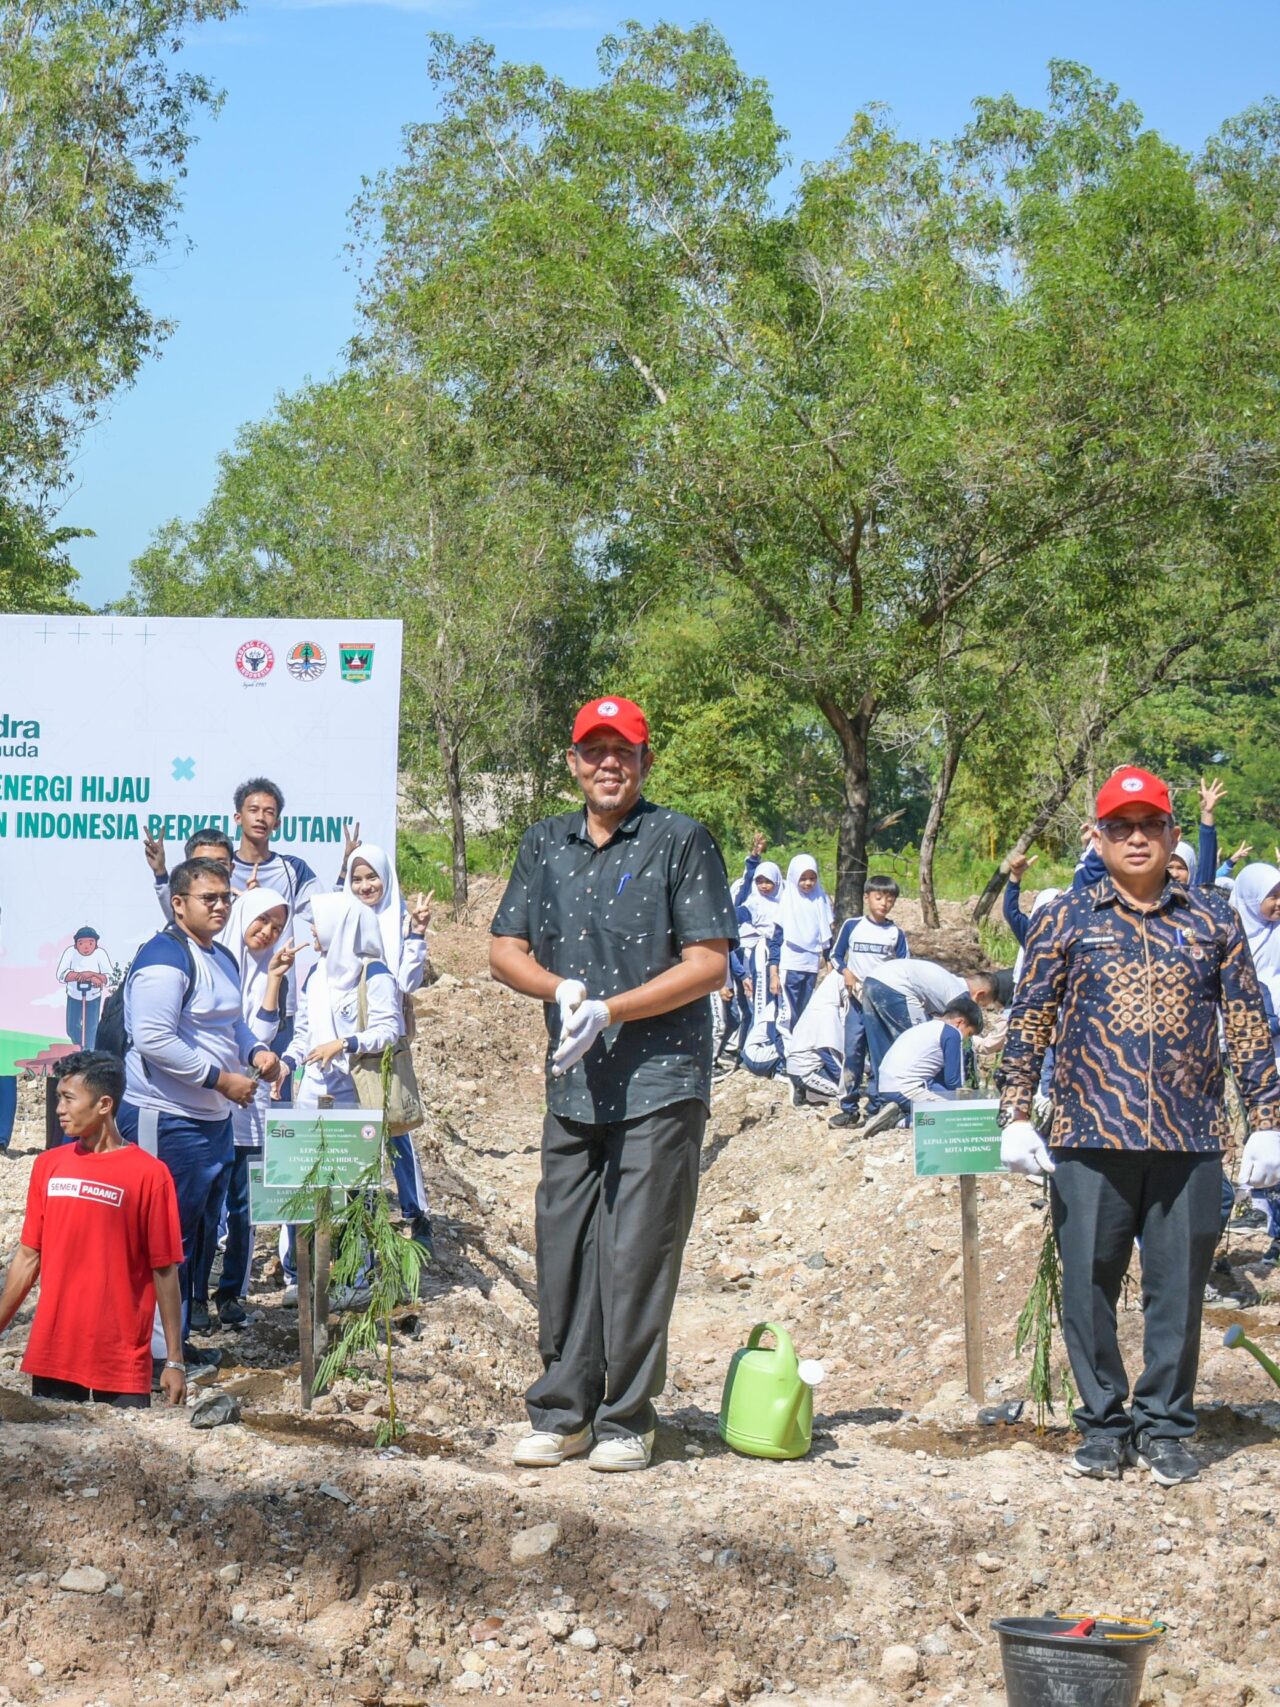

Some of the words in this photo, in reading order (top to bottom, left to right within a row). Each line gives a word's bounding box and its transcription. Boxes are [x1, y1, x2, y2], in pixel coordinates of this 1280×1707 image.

[81, 776, 150, 803] HIJAU
[16, 811, 139, 841] INDONESIA
[917, 1117, 936, 1126] SIG
[271, 1129, 295, 1138] SIG
[971, 1135, 1002, 1143] PENDID
[963, 1145, 992, 1153] PADANG
[50, 1183, 78, 1192] SEMEN
[81, 1185, 119, 1201] PADANG
